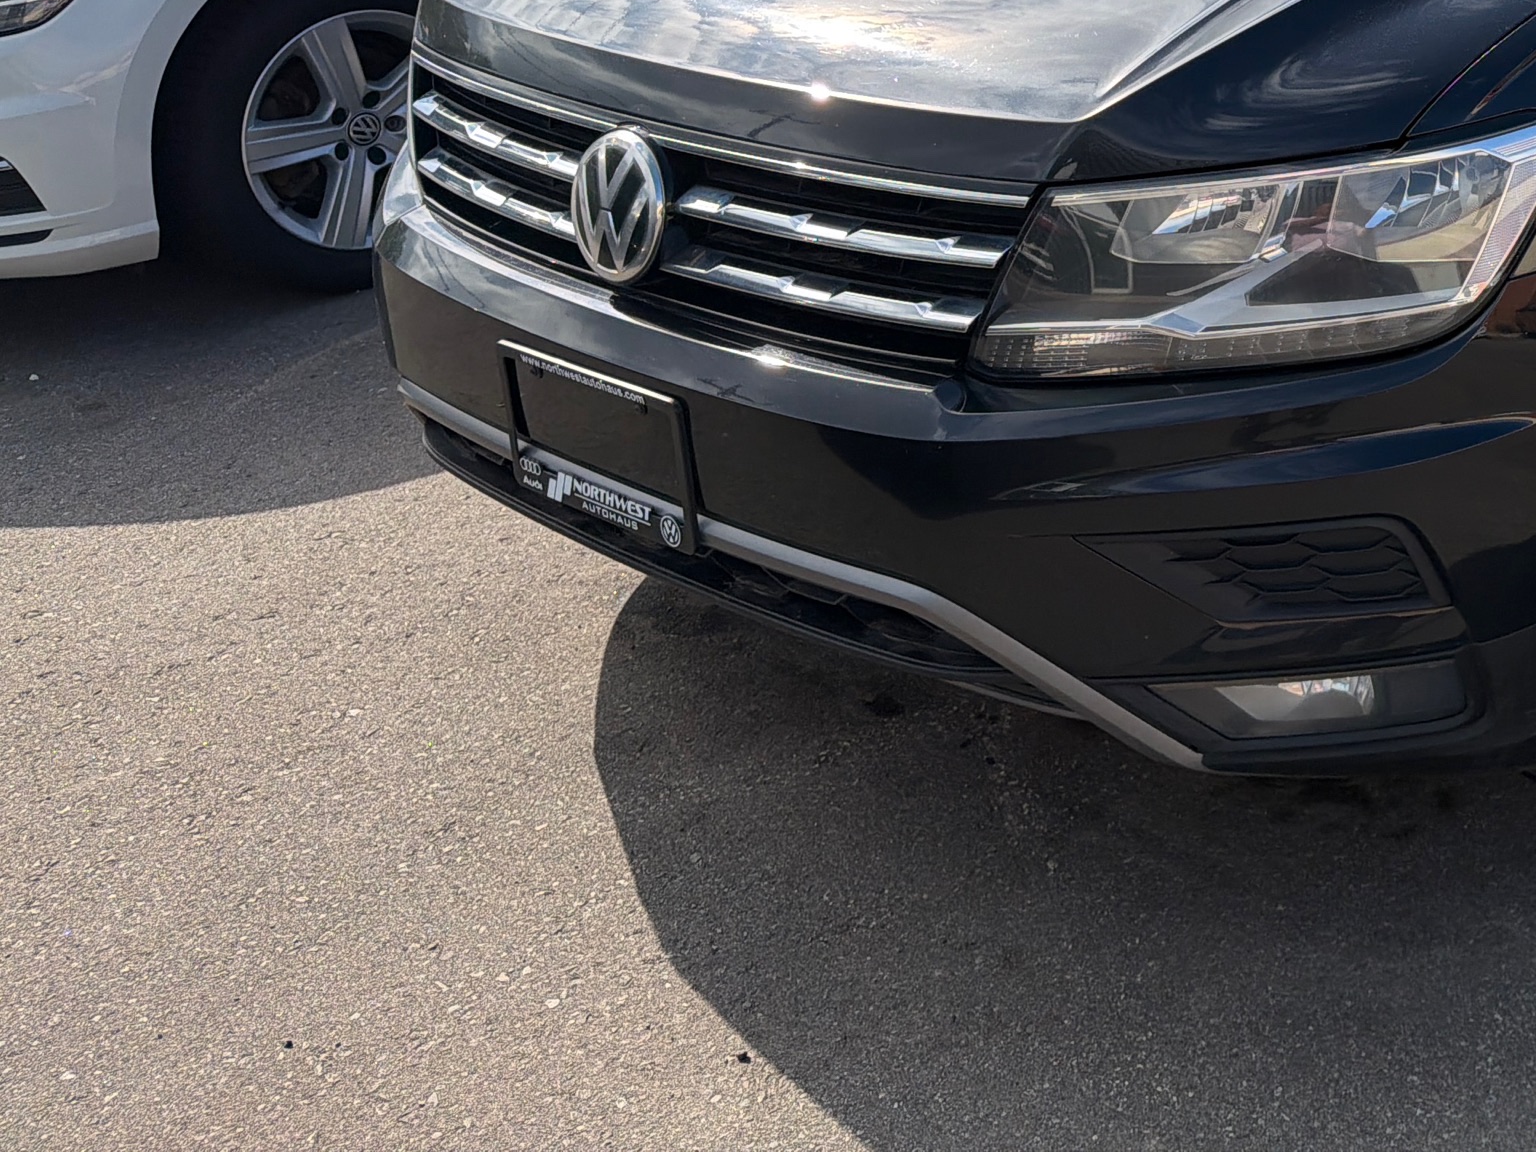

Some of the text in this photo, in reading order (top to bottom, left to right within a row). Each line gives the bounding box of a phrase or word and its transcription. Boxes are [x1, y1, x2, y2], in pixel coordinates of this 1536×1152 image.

[520, 354, 645, 406] www.northwestautohaus.com
[572, 478, 652, 522] NORTHWEST
[582, 501, 639, 531] AUTOHAUS
